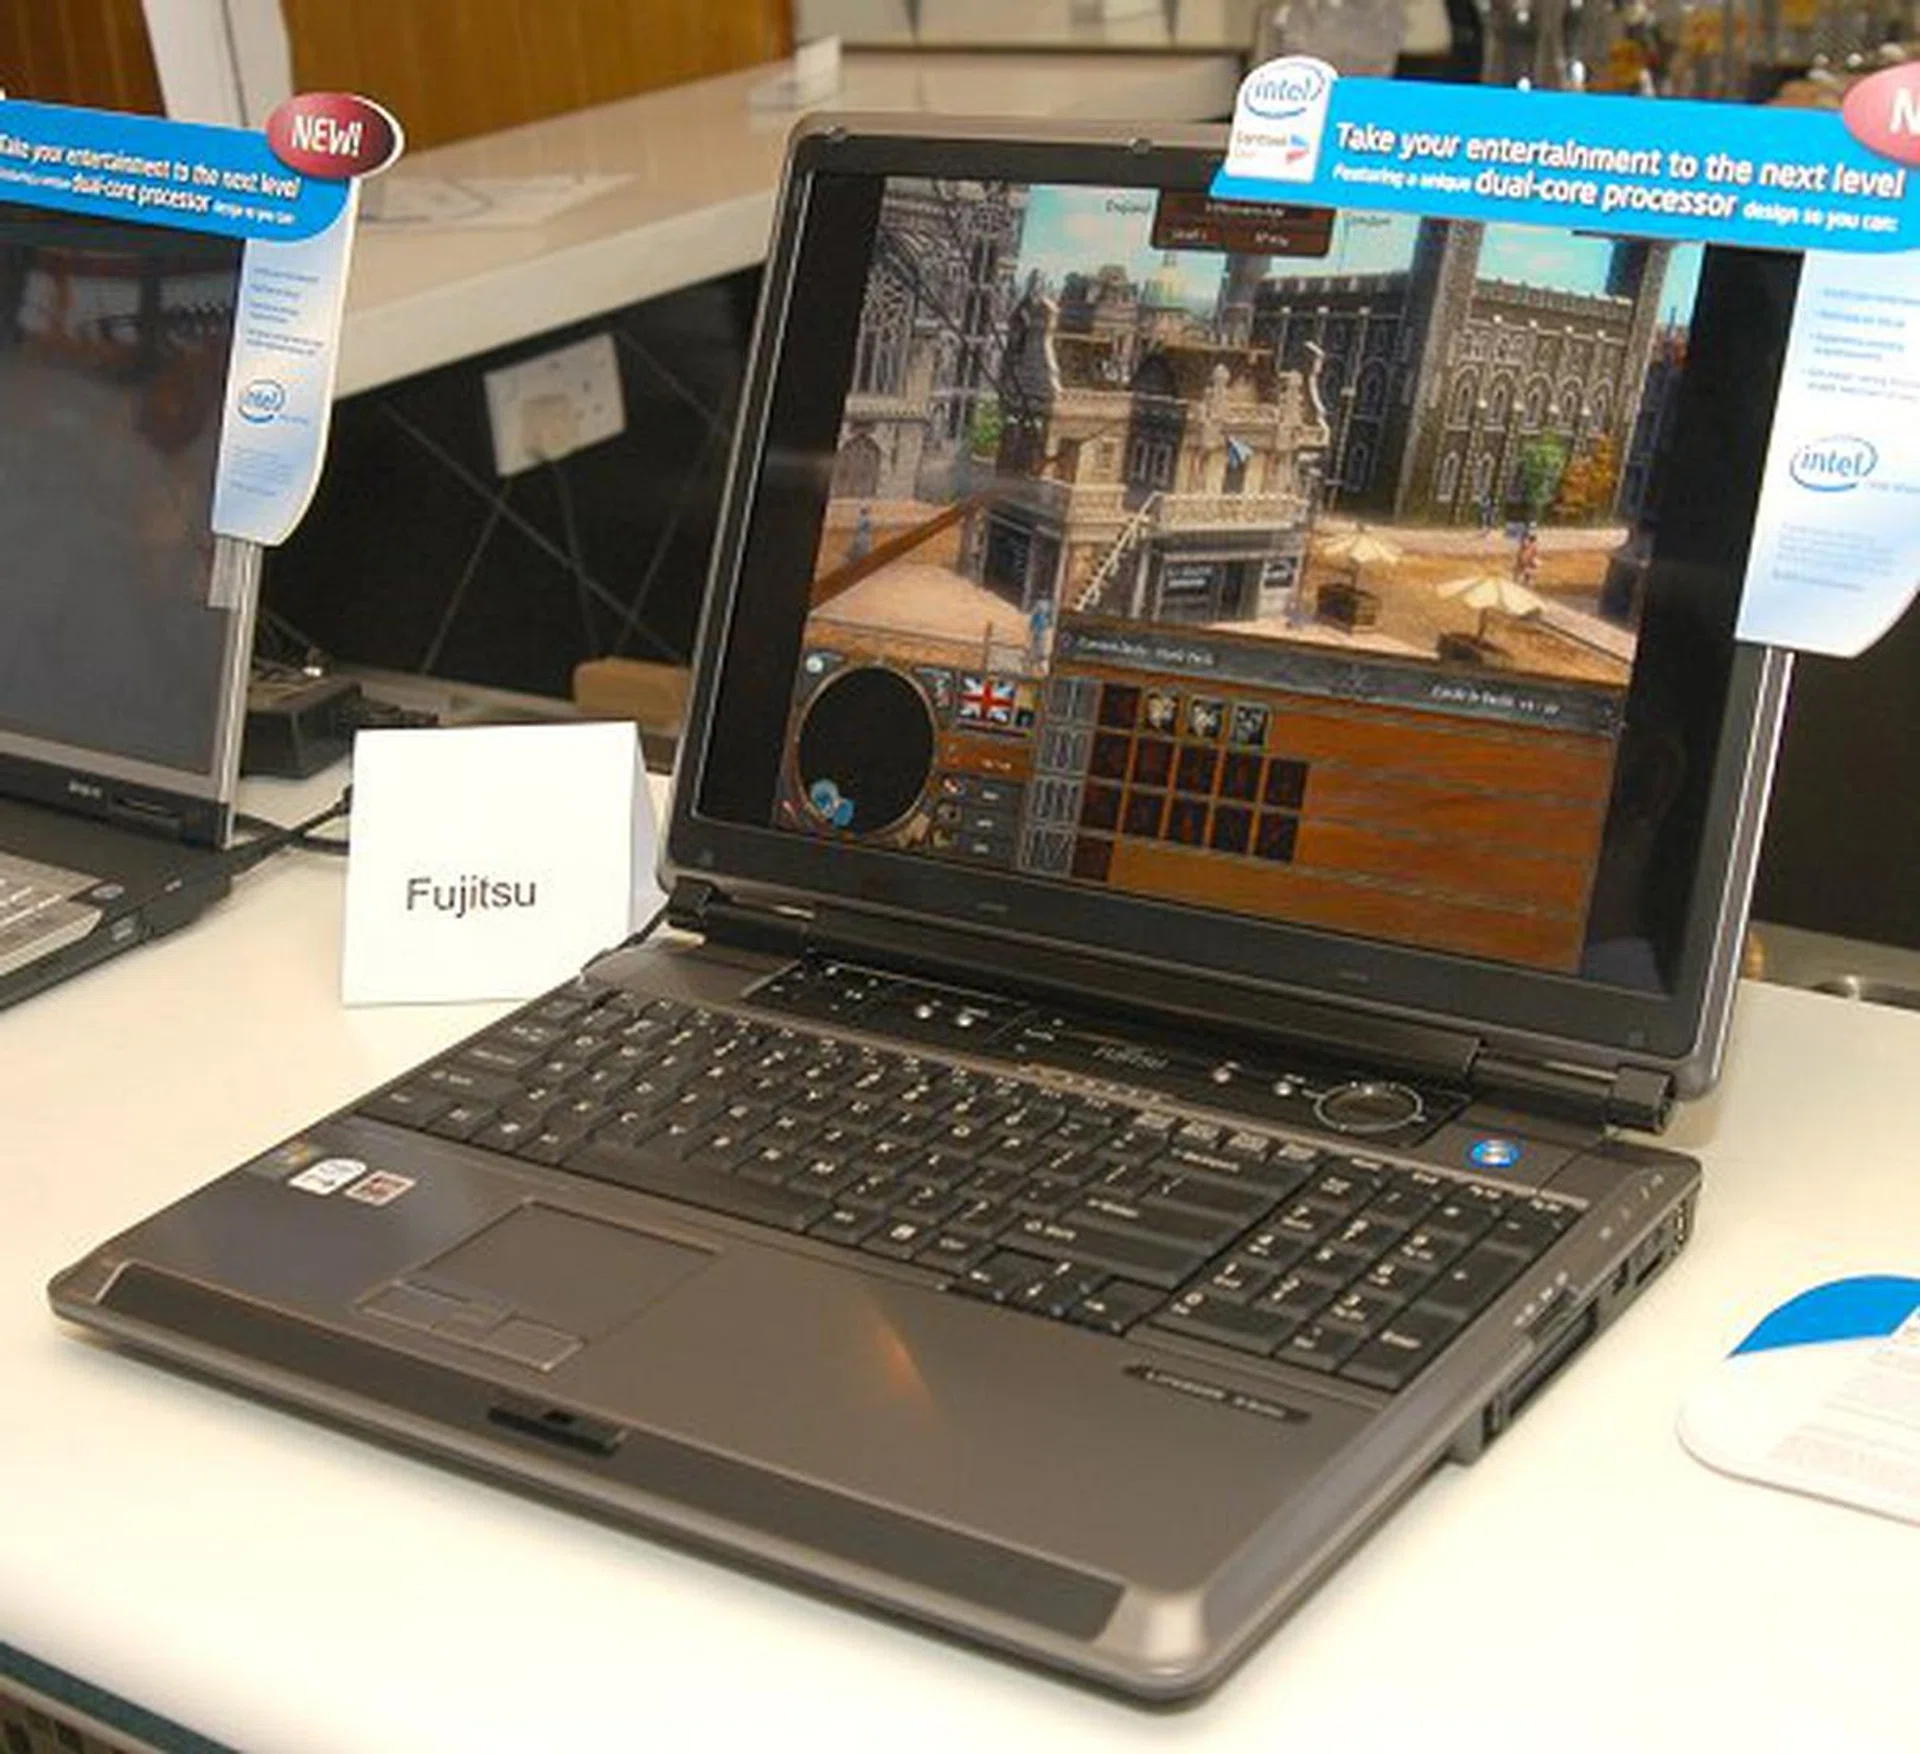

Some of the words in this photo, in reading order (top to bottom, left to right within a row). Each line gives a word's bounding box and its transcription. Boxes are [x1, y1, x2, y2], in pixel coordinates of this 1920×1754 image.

[290, 113, 363, 157] NEW!
[191, 162, 220, 187] the
[260, 171, 302, 199] level
[1336, 121, 1396, 152] Take
[1397, 131, 1461, 160] your
[1466, 136, 1662, 177] entertainment
[1668, 151, 1699, 179] to
[1705, 152, 1753, 185] the
[1758, 161, 1829, 191] next
[1831, 161, 1907, 199] level
[1474, 166, 1599, 204] dual-core
[1601, 182, 1740, 218] processor
[1742, 201, 1799, 226] design
[1802, 207, 1824, 226] so
[1825, 209, 1860, 232] you
[405, 874, 538, 919] Fujitsu
